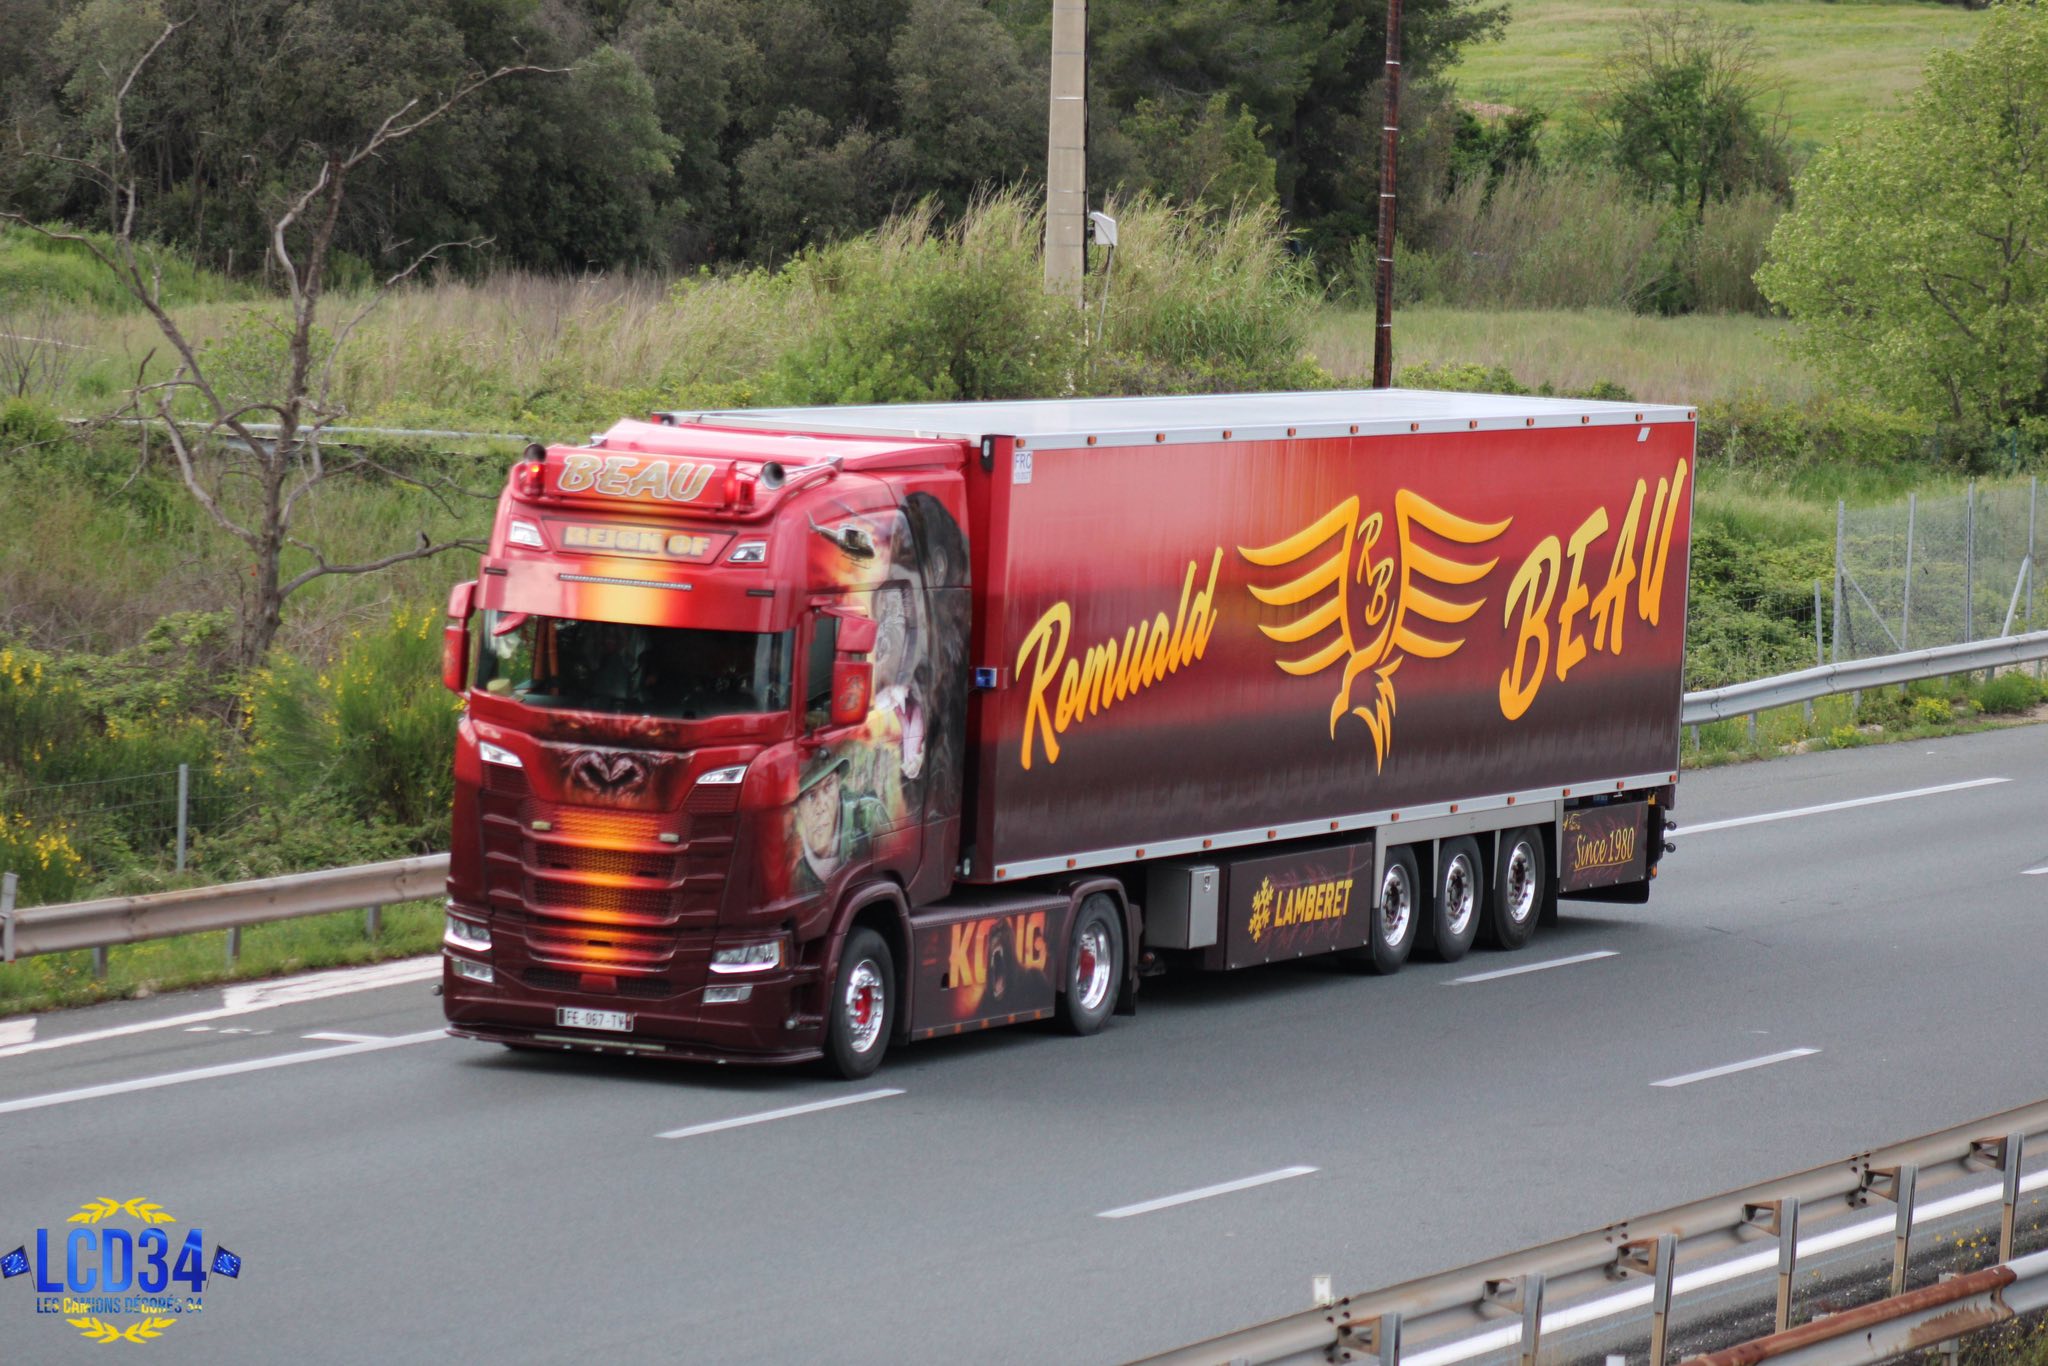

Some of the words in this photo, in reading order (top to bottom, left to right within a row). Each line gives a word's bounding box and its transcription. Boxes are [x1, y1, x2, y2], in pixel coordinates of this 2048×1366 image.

[558, 454, 716, 501] BEAU
[1015, 453, 1032, 470] FRC
[666, 535, 711, 557] OF
[1499, 458, 1687, 720] BEAU
[1016, 547, 1223, 770] Romuald
[1574, 834, 1607, 869] Since
[1608, 827, 1635, 863] 1980
[1274, 879, 1354, 928] LAMBERET
